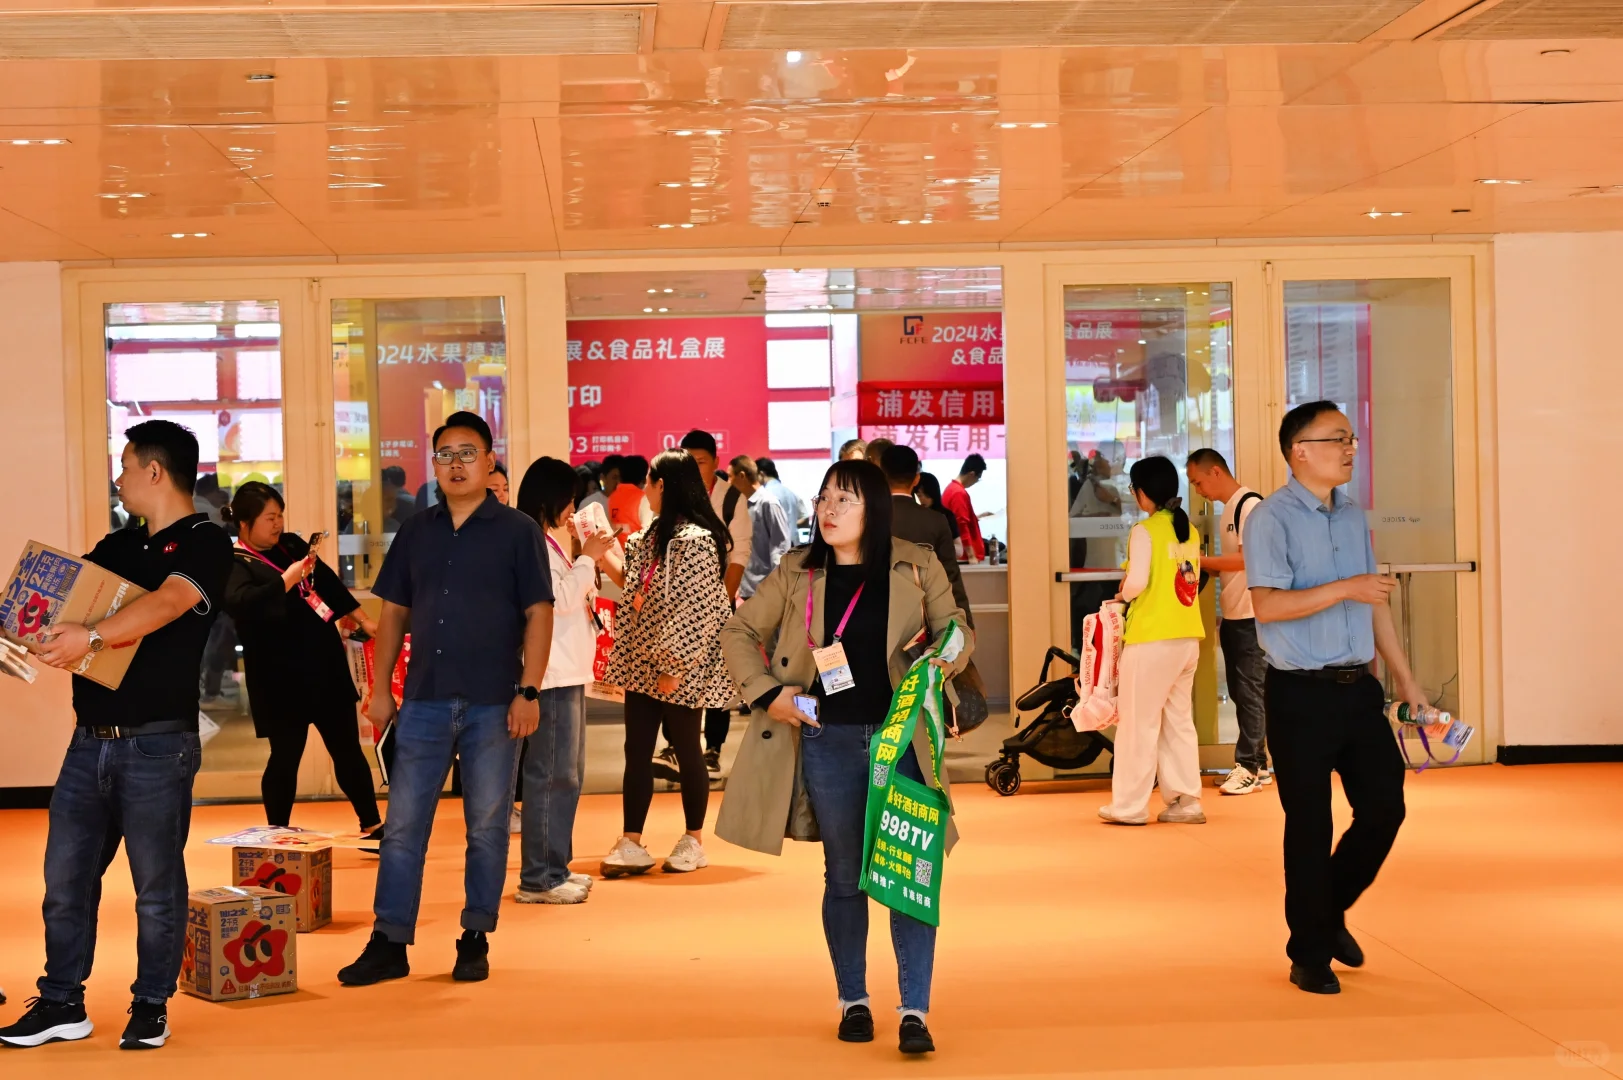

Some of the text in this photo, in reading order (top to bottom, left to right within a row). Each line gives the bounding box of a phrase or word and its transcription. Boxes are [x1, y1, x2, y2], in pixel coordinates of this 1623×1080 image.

[932, 323, 1003, 343] 2024水
[454, 387, 502, 411] 胸卡
[876, 389, 1004, 418] 浦发信用
[569, 436, 589, 454] 3
[872, 425, 1006, 452] 发信用
[28, 554, 55, 588] 2千克
[870, 869, 896, 890] 网推广
